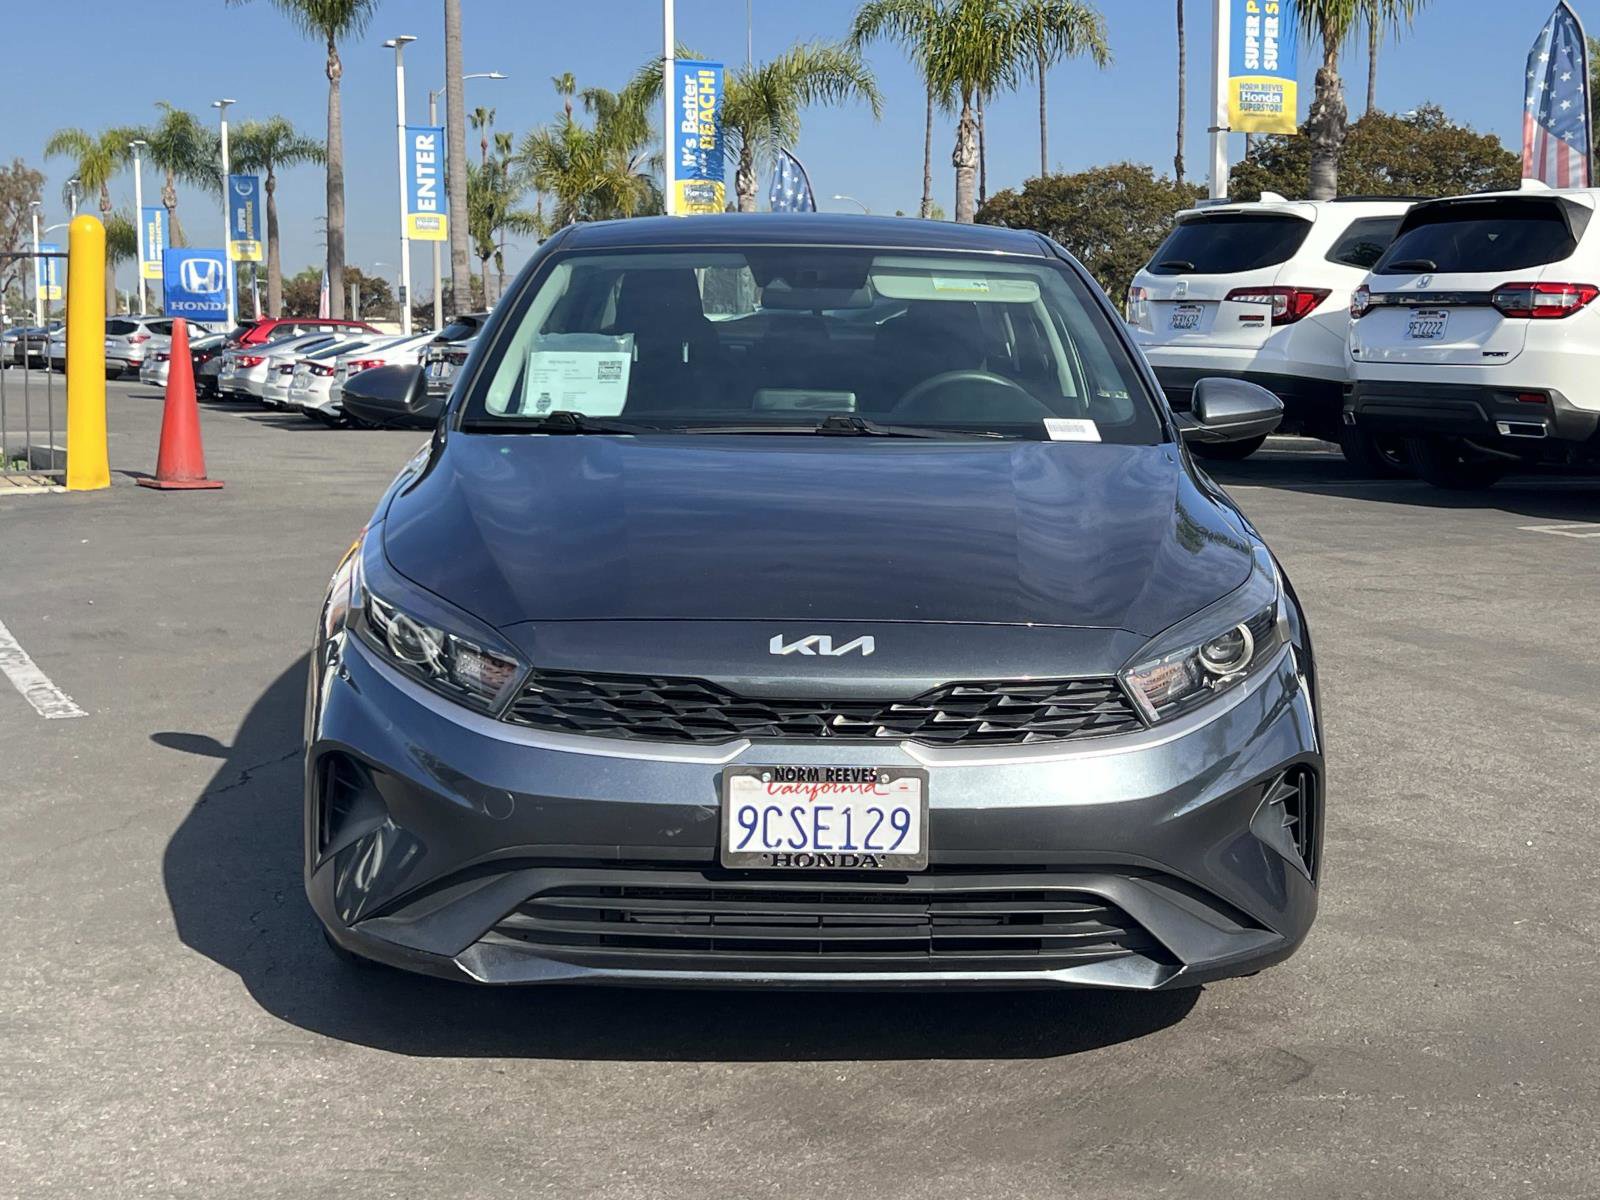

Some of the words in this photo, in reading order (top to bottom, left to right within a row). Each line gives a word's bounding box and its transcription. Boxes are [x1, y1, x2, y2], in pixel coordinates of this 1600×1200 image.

[1265, 0, 1279, 15] S
[1245, 16, 1260, 69] SUPER
[1263, 17, 1279, 70] SUPER
[682, 75, 698, 133] Better
[1240, 103, 1283, 112] SUPERSTORE
[1242, 91, 1281, 102] Honda
[698, 70, 716, 150] BEACH!
[682, 138, 698, 166] It's
[416, 134, 436, 211] ENTER
[770, 634, 875, 656] KIA
[774, 767, 820, 782] NORM
[826, 767, 877, 782] REEVES
[766, 780, 889, 802] California
[737, 805, 911, 851] 9CSE129
[772, 853, 884, 868] HONDA
